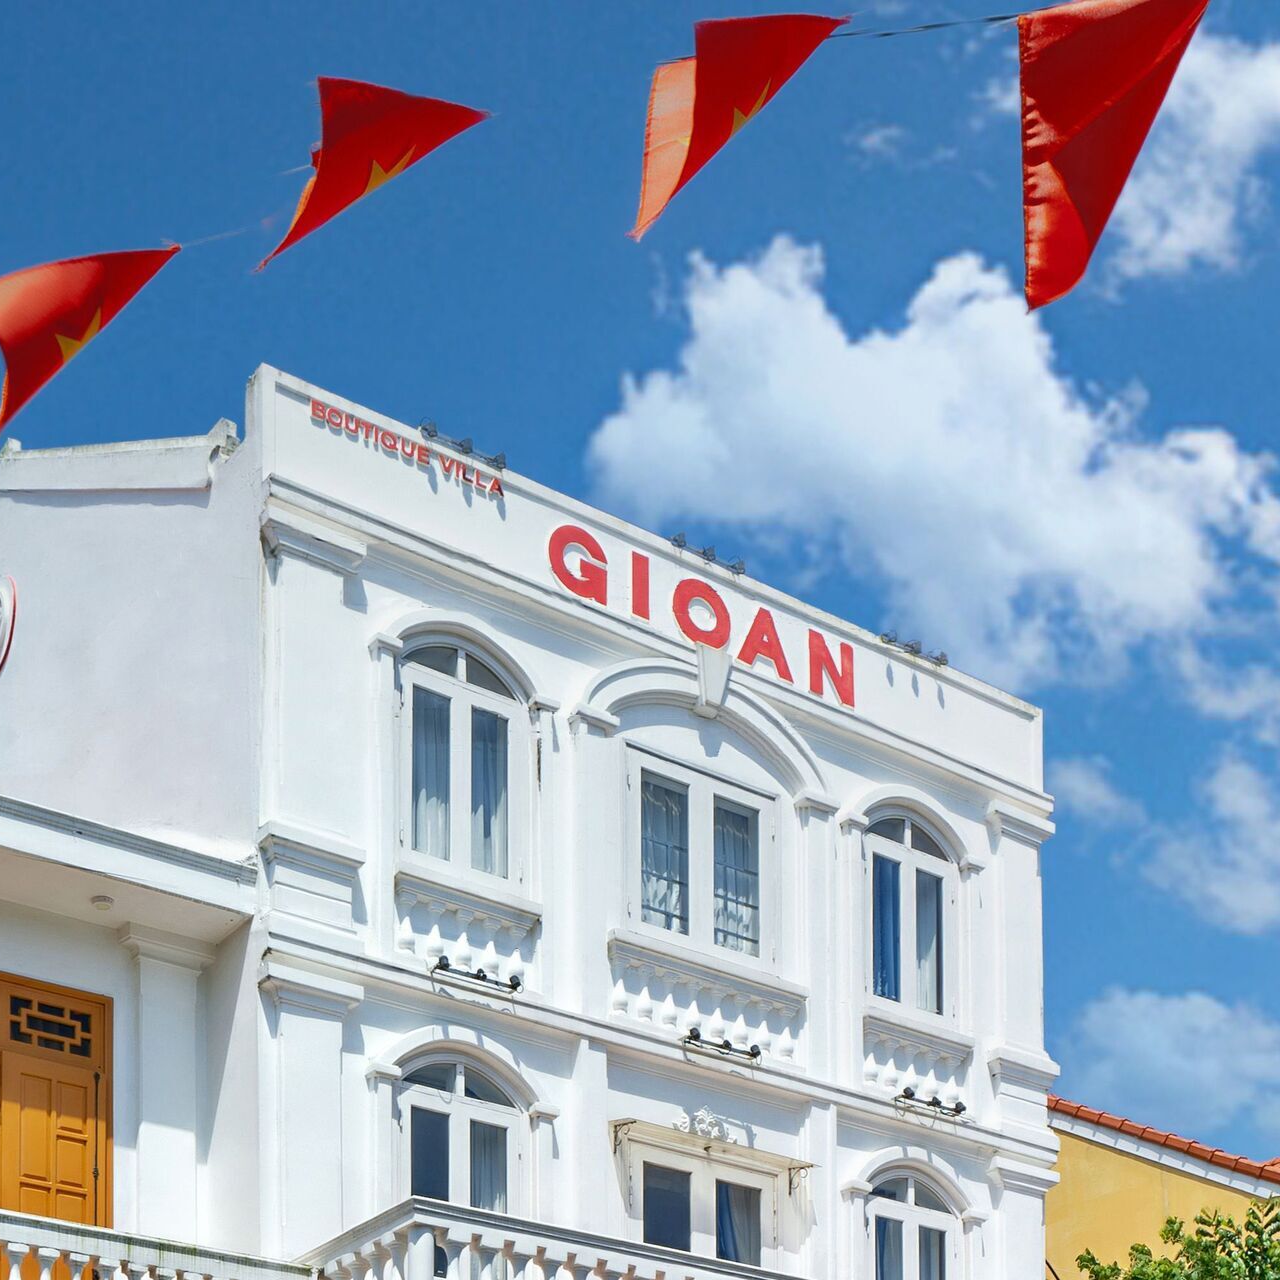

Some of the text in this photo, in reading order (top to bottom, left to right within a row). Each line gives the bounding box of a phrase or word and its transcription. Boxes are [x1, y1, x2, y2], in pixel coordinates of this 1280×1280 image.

[309, 397, 504, 497] BOUTIQUE VILLA
[547, 524, 855, 709] GIOAN
